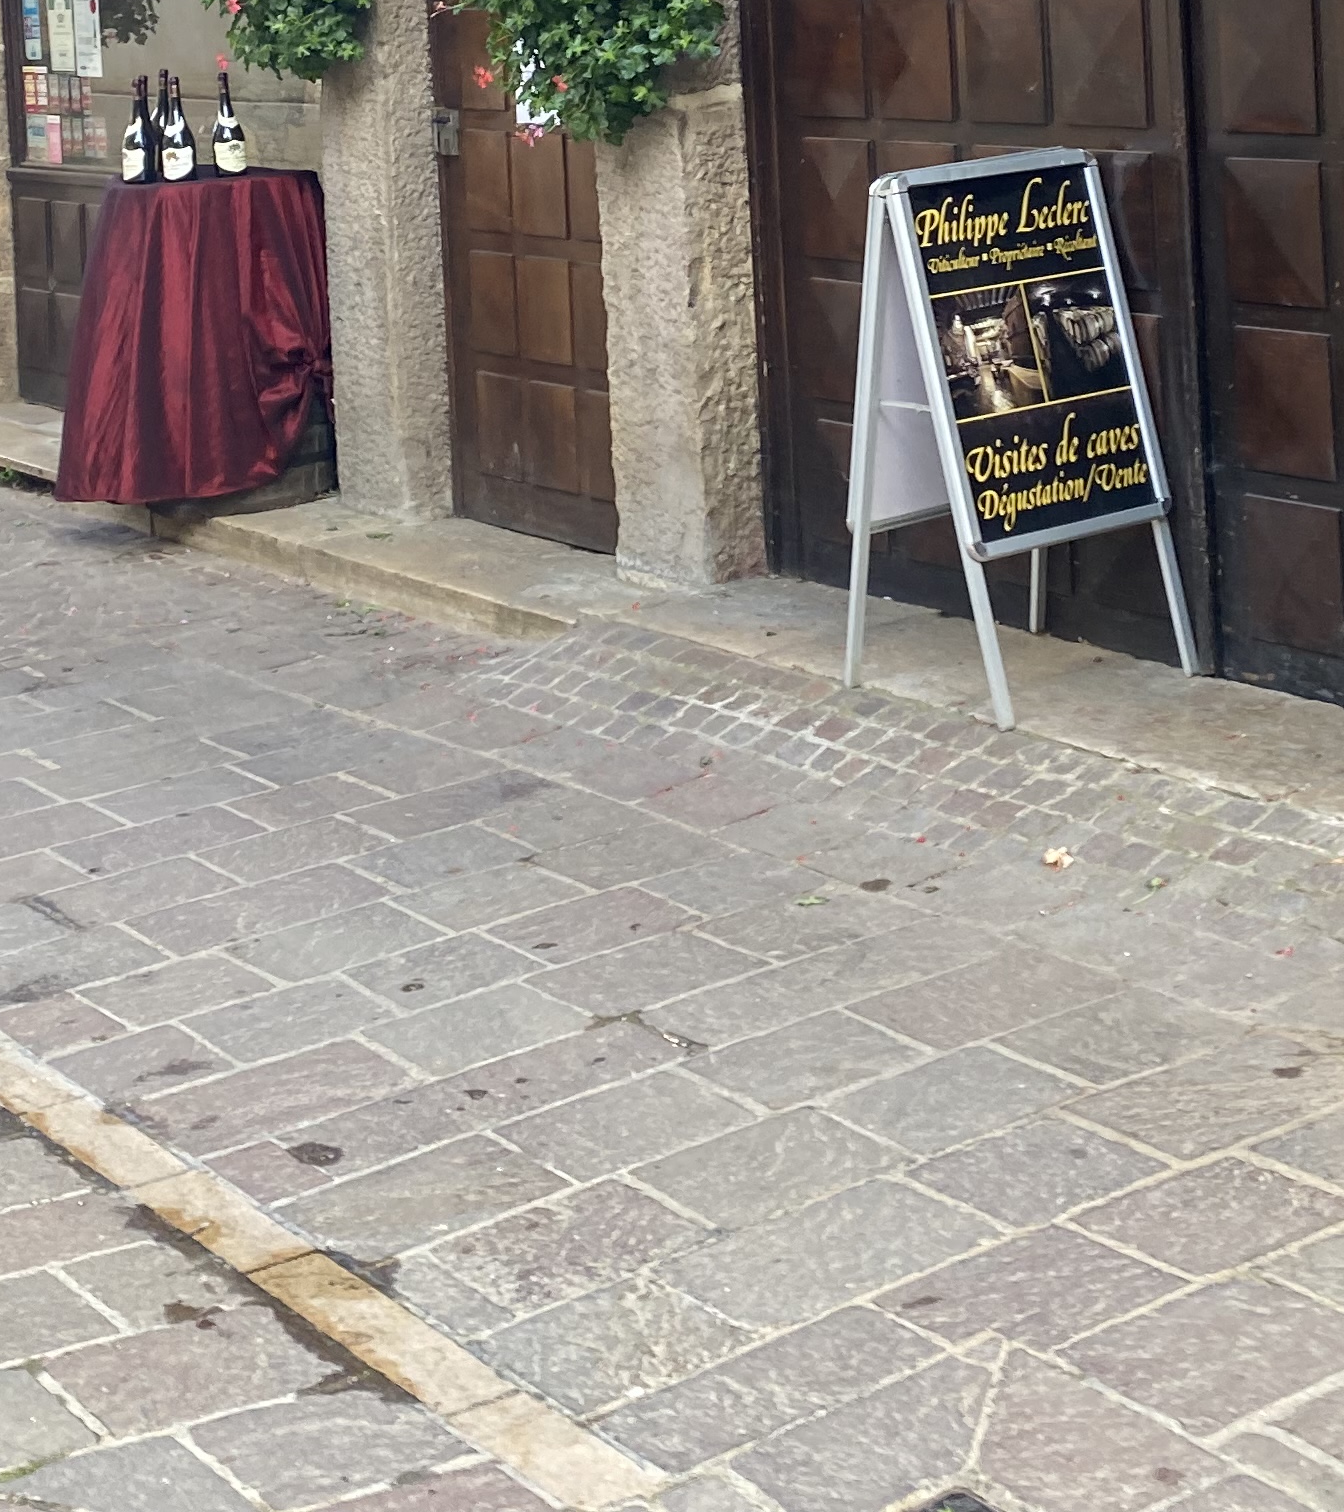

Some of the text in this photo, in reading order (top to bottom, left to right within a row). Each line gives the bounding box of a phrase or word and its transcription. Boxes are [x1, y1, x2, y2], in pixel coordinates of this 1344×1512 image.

[915, 177, 1090, 248] Philippe Leclerc
[965, 412, 1140, 483] Visites de caves
